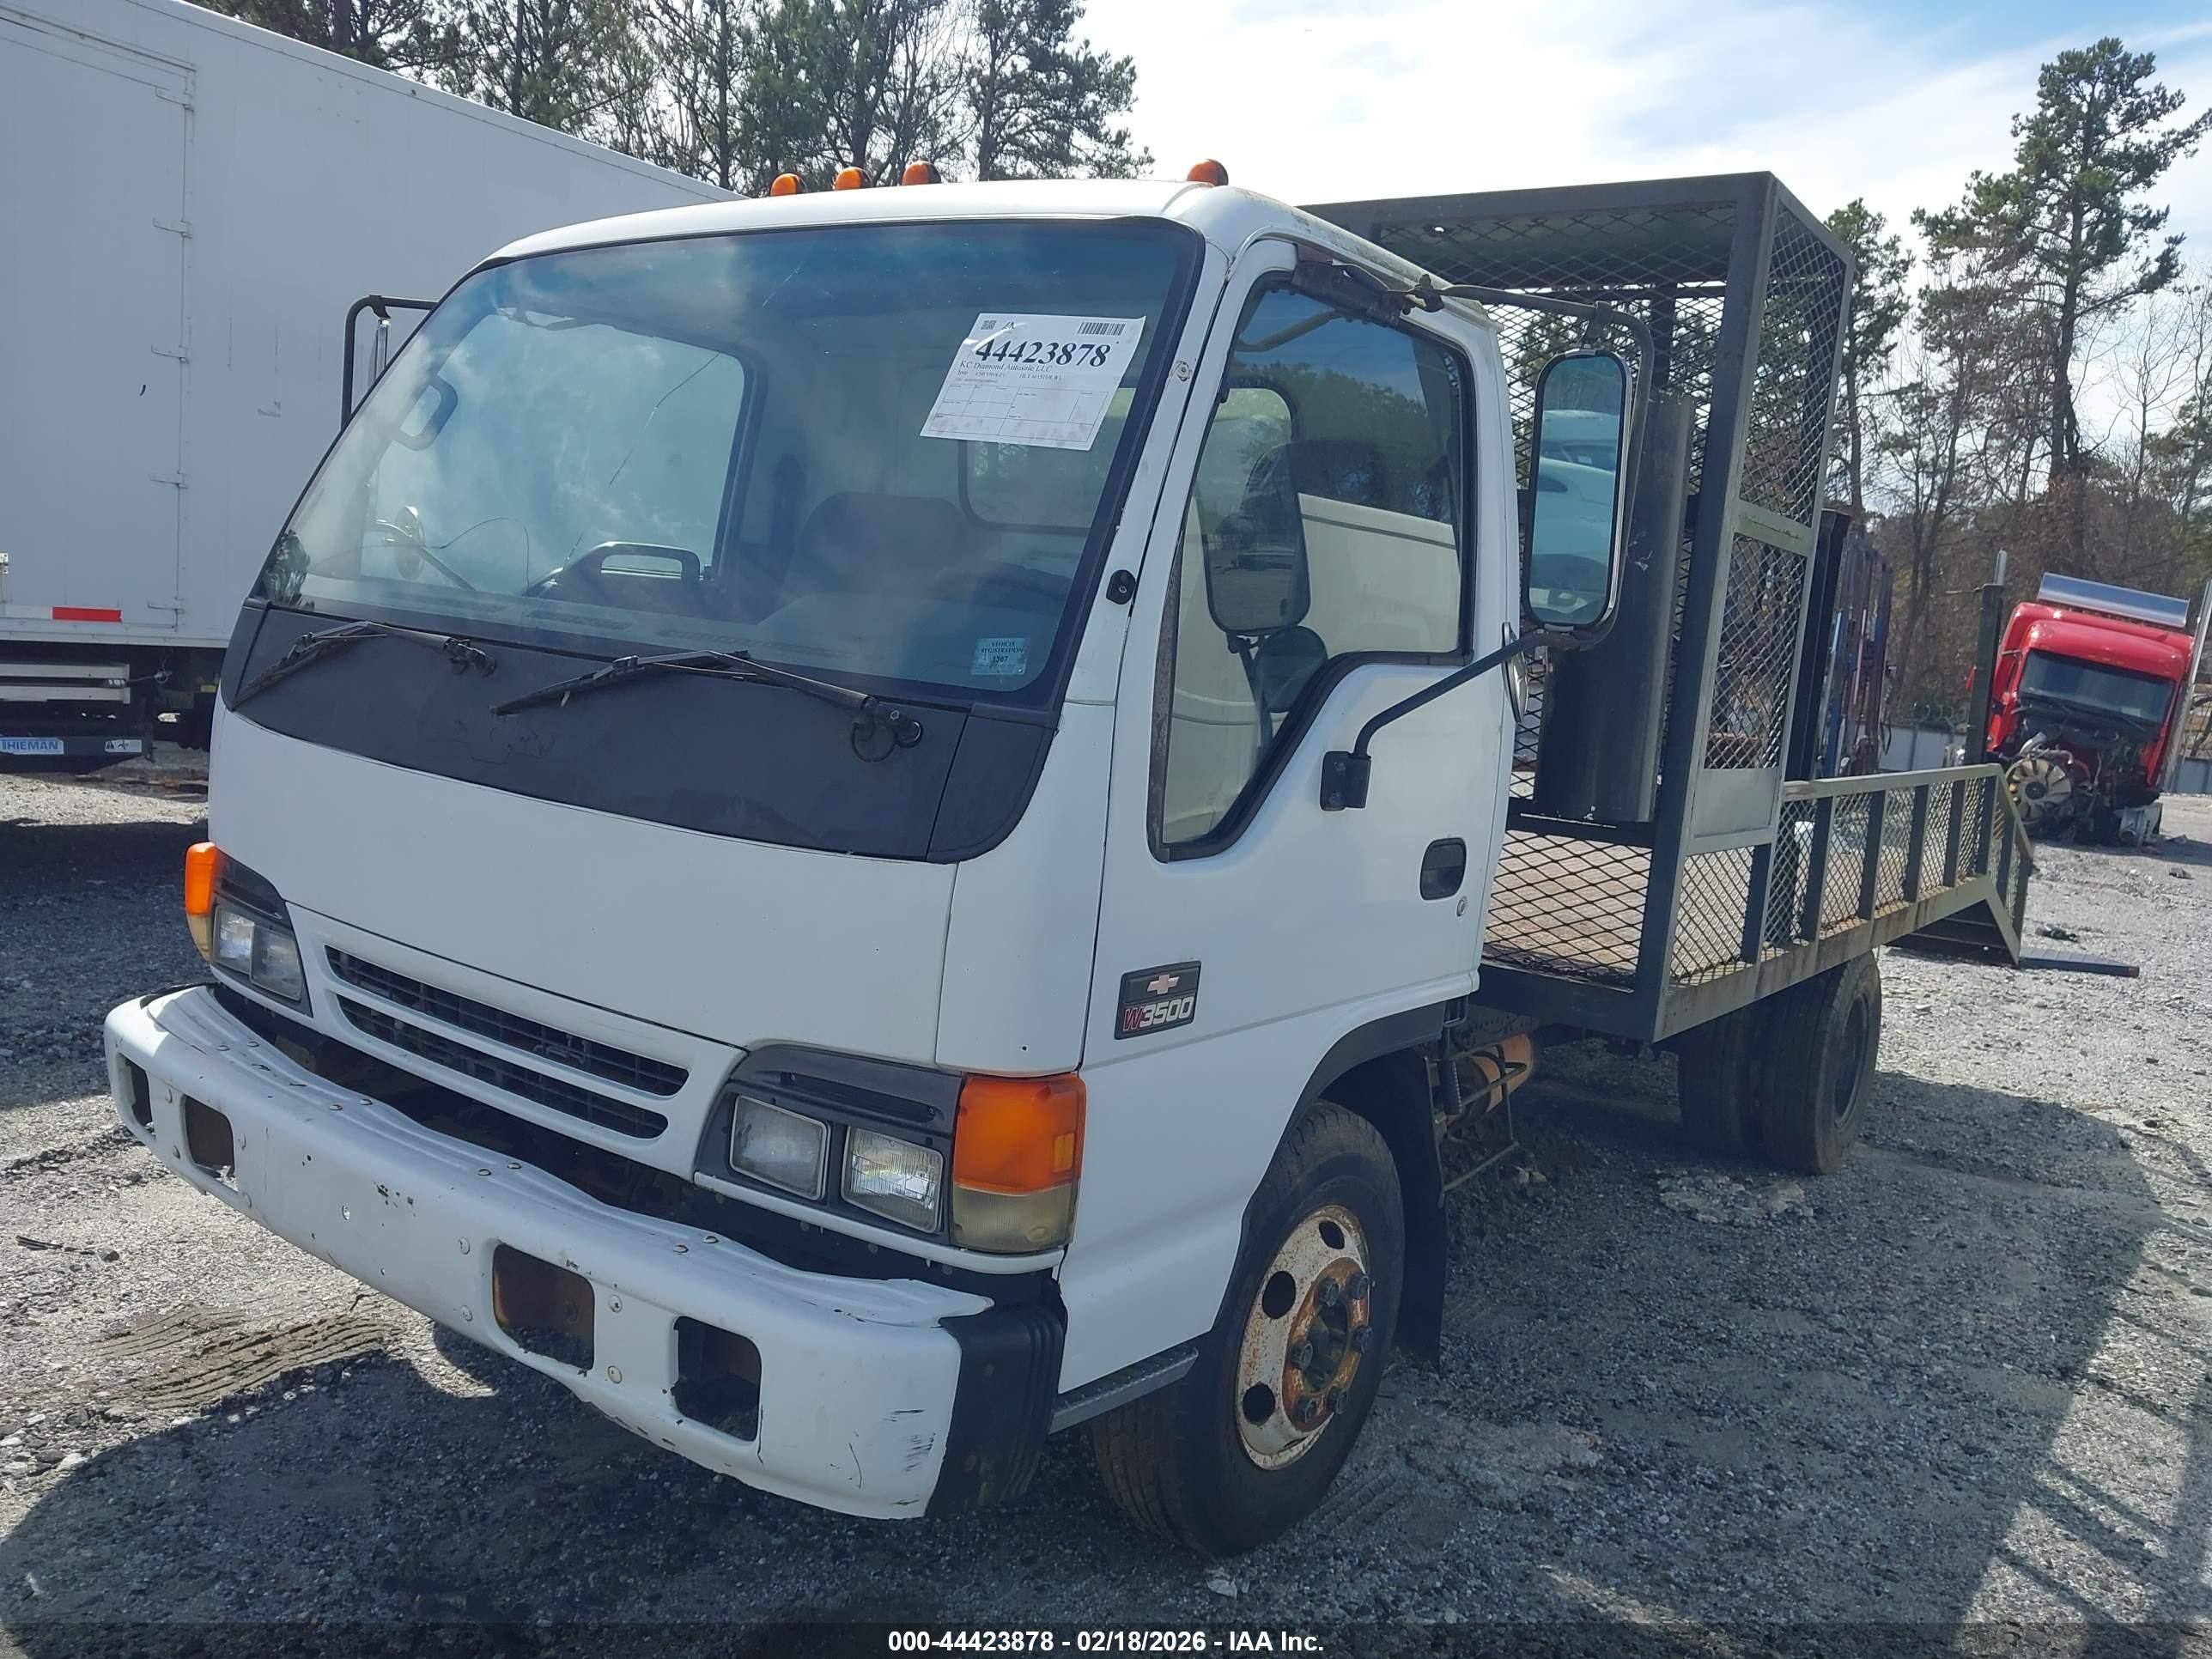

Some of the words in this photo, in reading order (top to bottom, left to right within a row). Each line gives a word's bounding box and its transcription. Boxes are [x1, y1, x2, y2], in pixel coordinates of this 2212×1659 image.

[960, 360, 973, 369] KC
[974, 362, 1005, 371] Diamond
[975, 338, 1111, 368] 44423878
[1122, 996, 1194, 1031] W3500
